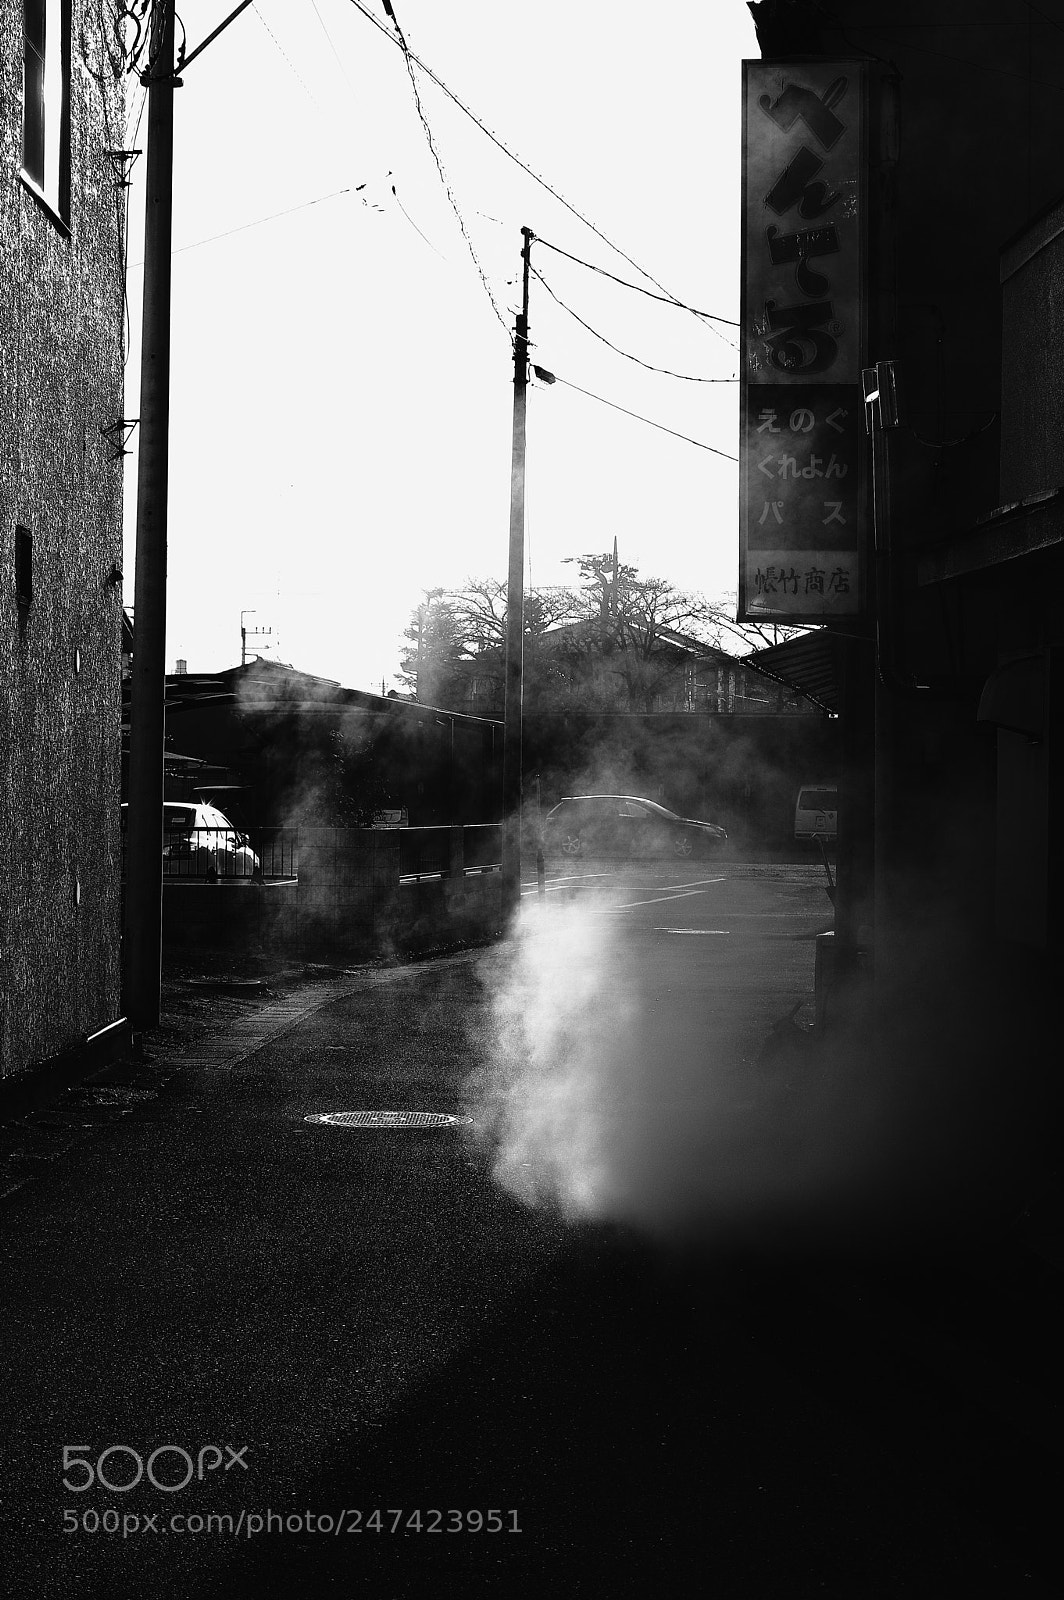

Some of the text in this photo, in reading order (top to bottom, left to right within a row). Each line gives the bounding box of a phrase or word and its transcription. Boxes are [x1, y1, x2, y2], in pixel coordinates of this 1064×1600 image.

[756, 408, 848, 433] えのぐ
[757, 453, 848, 479] くれよん
